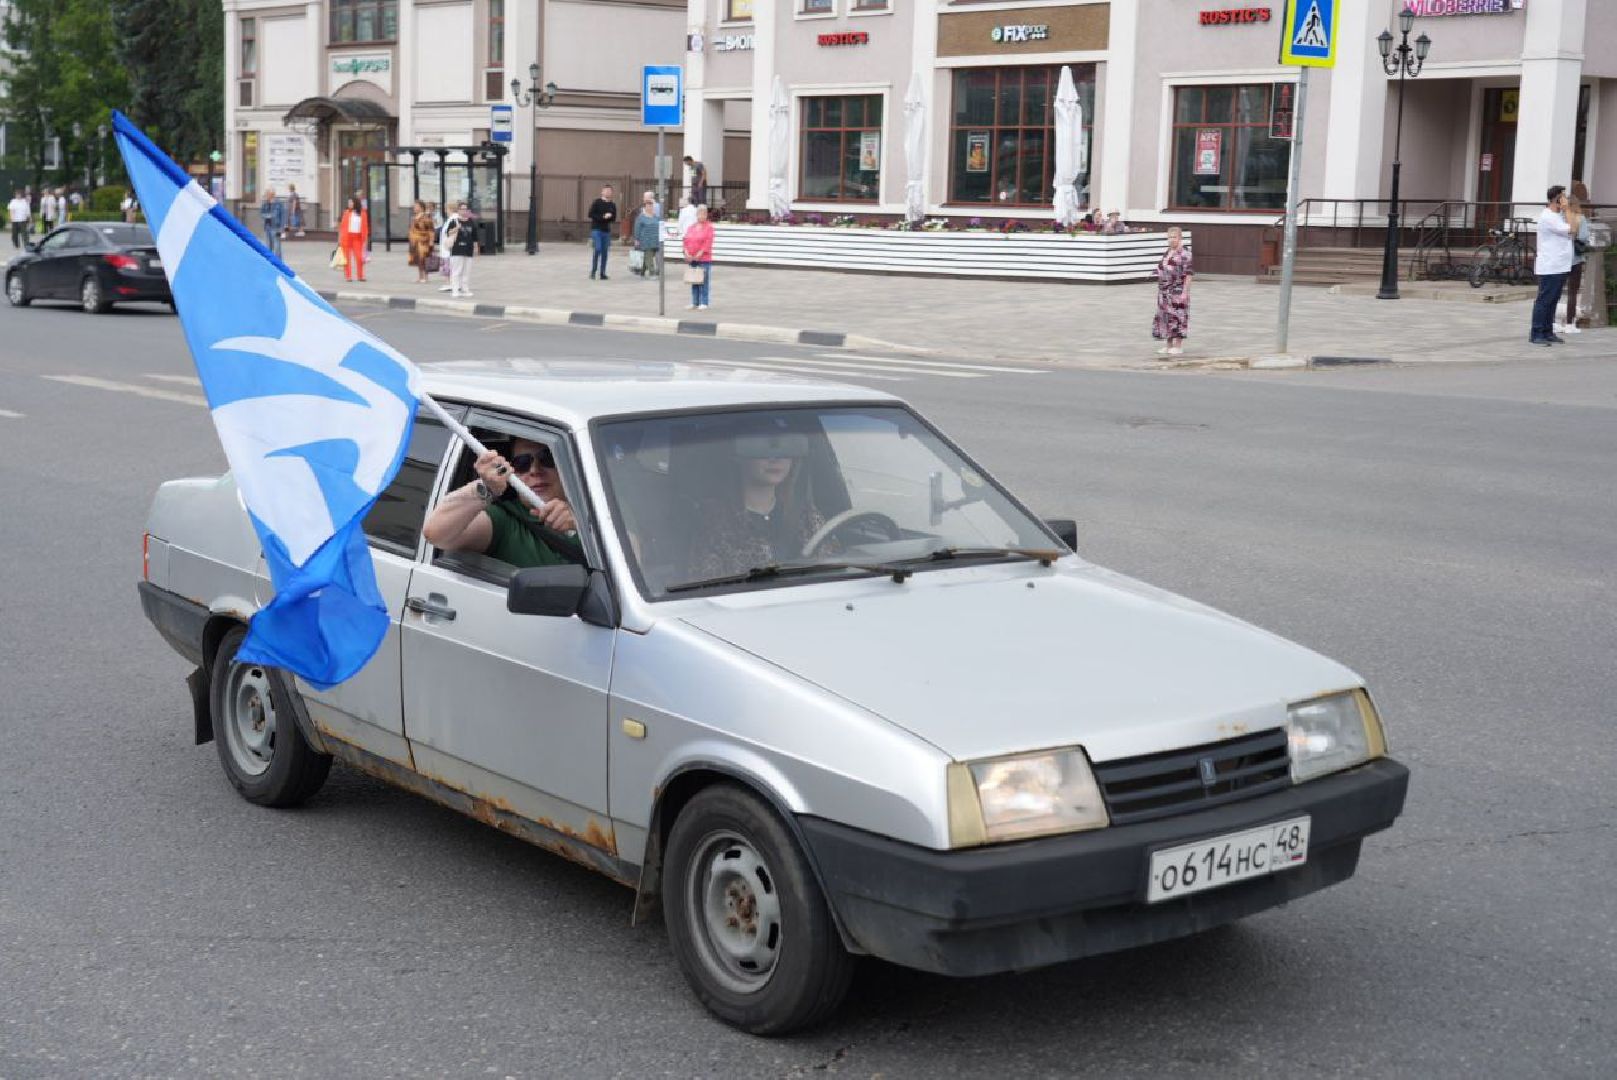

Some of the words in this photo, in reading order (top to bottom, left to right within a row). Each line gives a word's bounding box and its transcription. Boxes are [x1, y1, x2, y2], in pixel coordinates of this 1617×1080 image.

[1199, 8, 1272, 25] RUSTIC'S
[1003, 25, 1027, 42] FIX
[1276, 825, 1300, 852] 48
